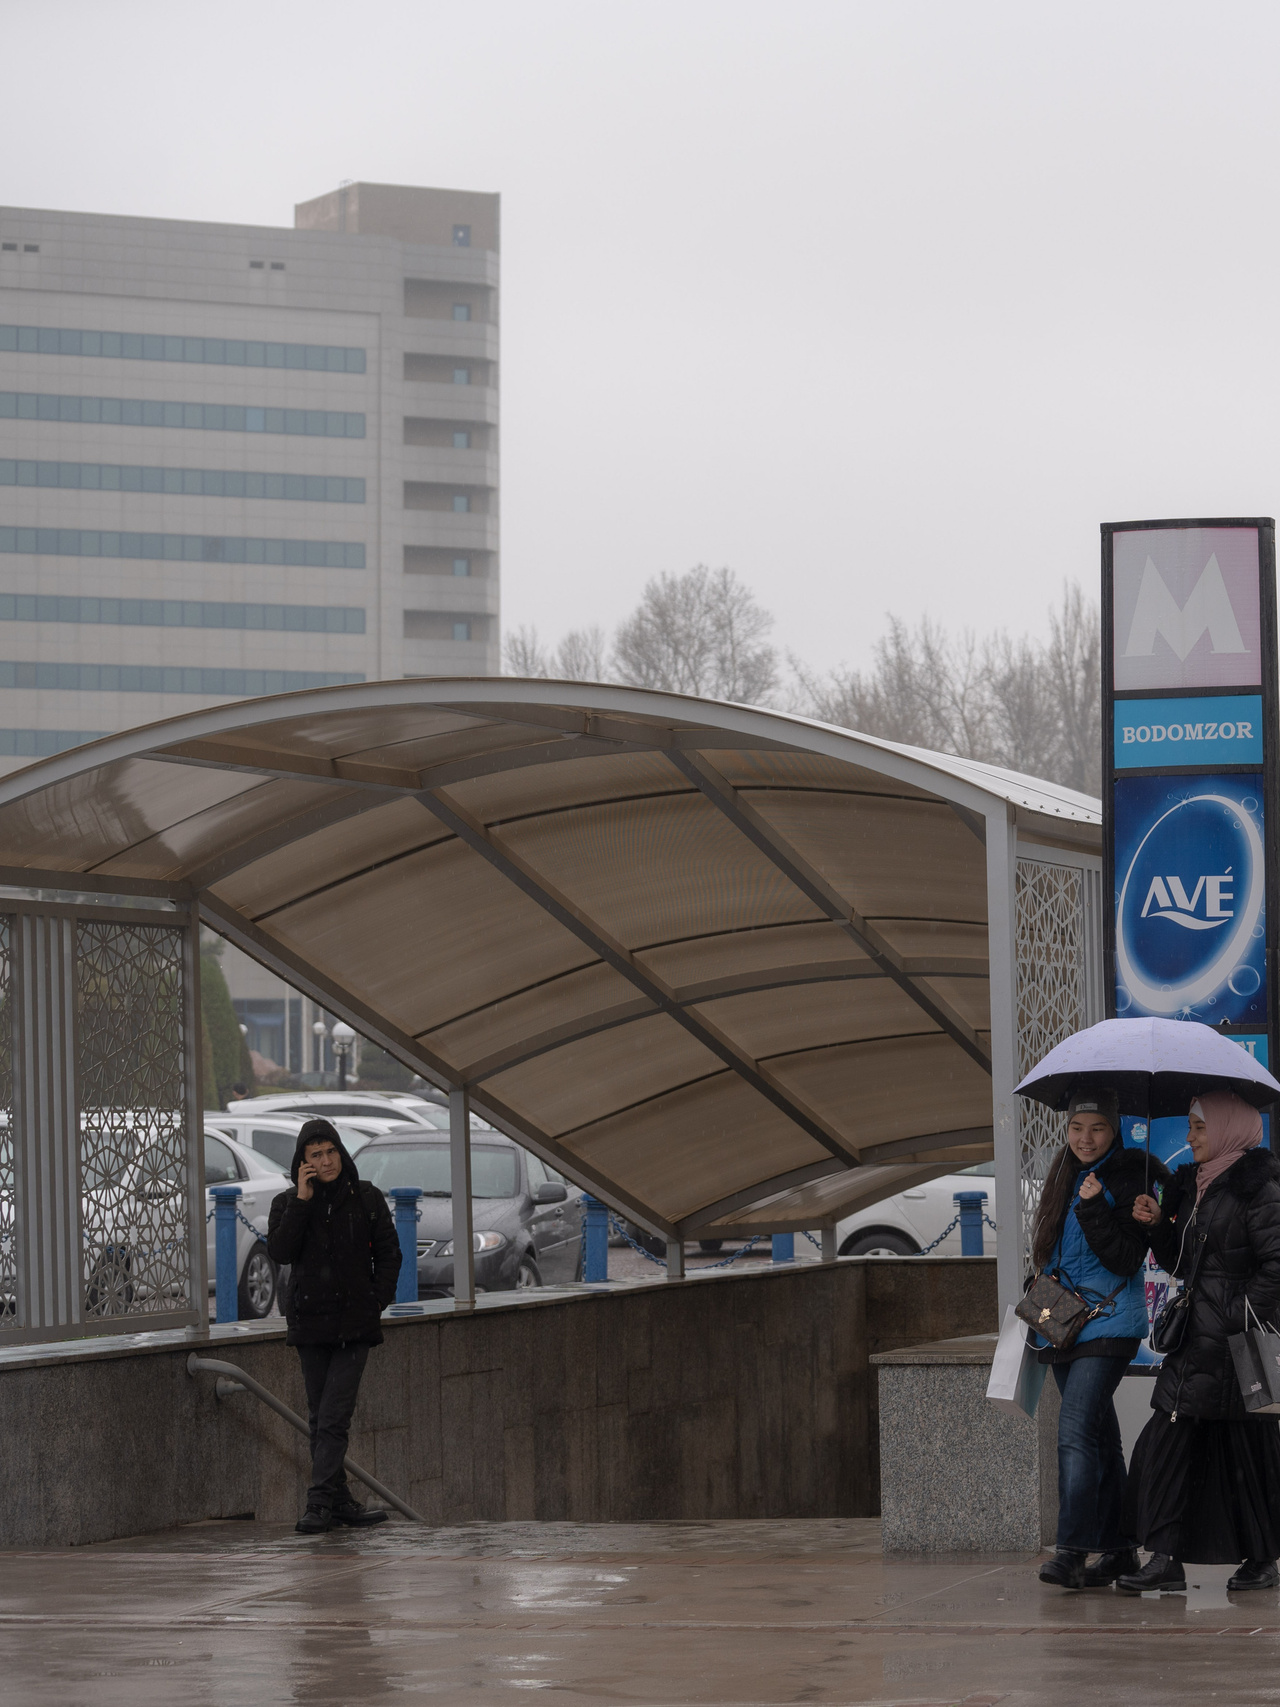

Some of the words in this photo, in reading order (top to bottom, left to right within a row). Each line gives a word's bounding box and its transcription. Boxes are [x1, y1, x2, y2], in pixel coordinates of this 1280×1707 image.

[1120, 552, 1251, 662] M
[1122, 721, 1253, 744] BODOMZOR
[1140, 866, 1234, 918] AVÉ
